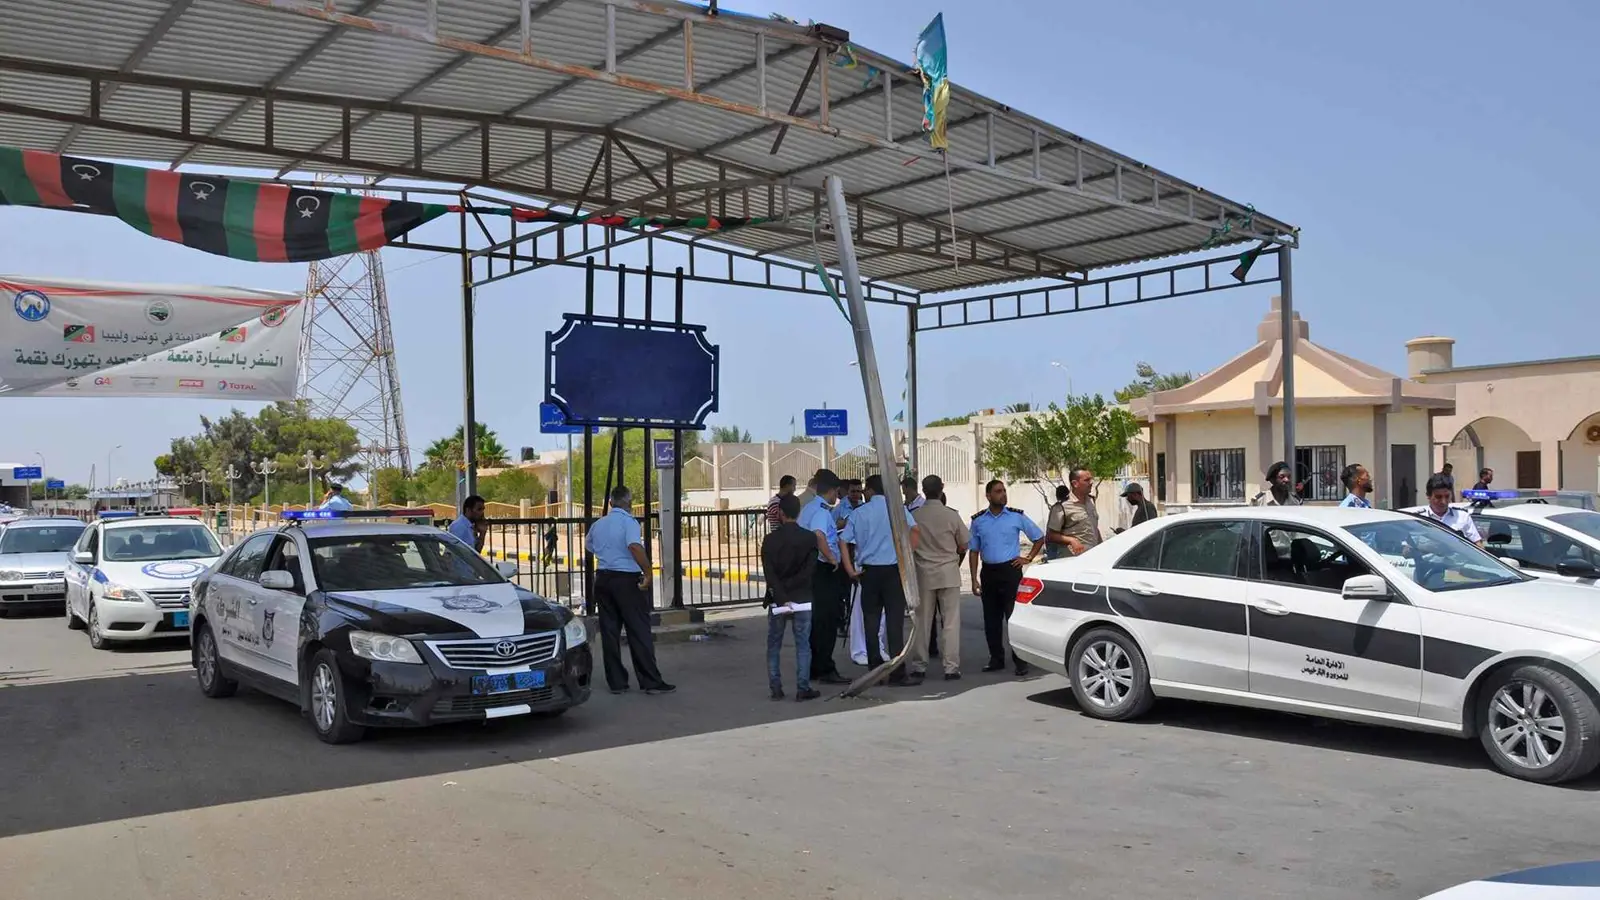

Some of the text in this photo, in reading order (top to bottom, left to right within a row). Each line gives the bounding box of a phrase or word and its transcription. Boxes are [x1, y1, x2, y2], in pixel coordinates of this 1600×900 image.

[101, 330, 129, 343] وليبيا
[131, 332, 159, 344] تونس
[161, 332, 173, 345] في
[14, 348, 49, 366] نقمة
[167, 349, 194, 362] متعة
[228, 382, 256, 390] TOTAL
[1306, 654, 1324, 665] العامة
